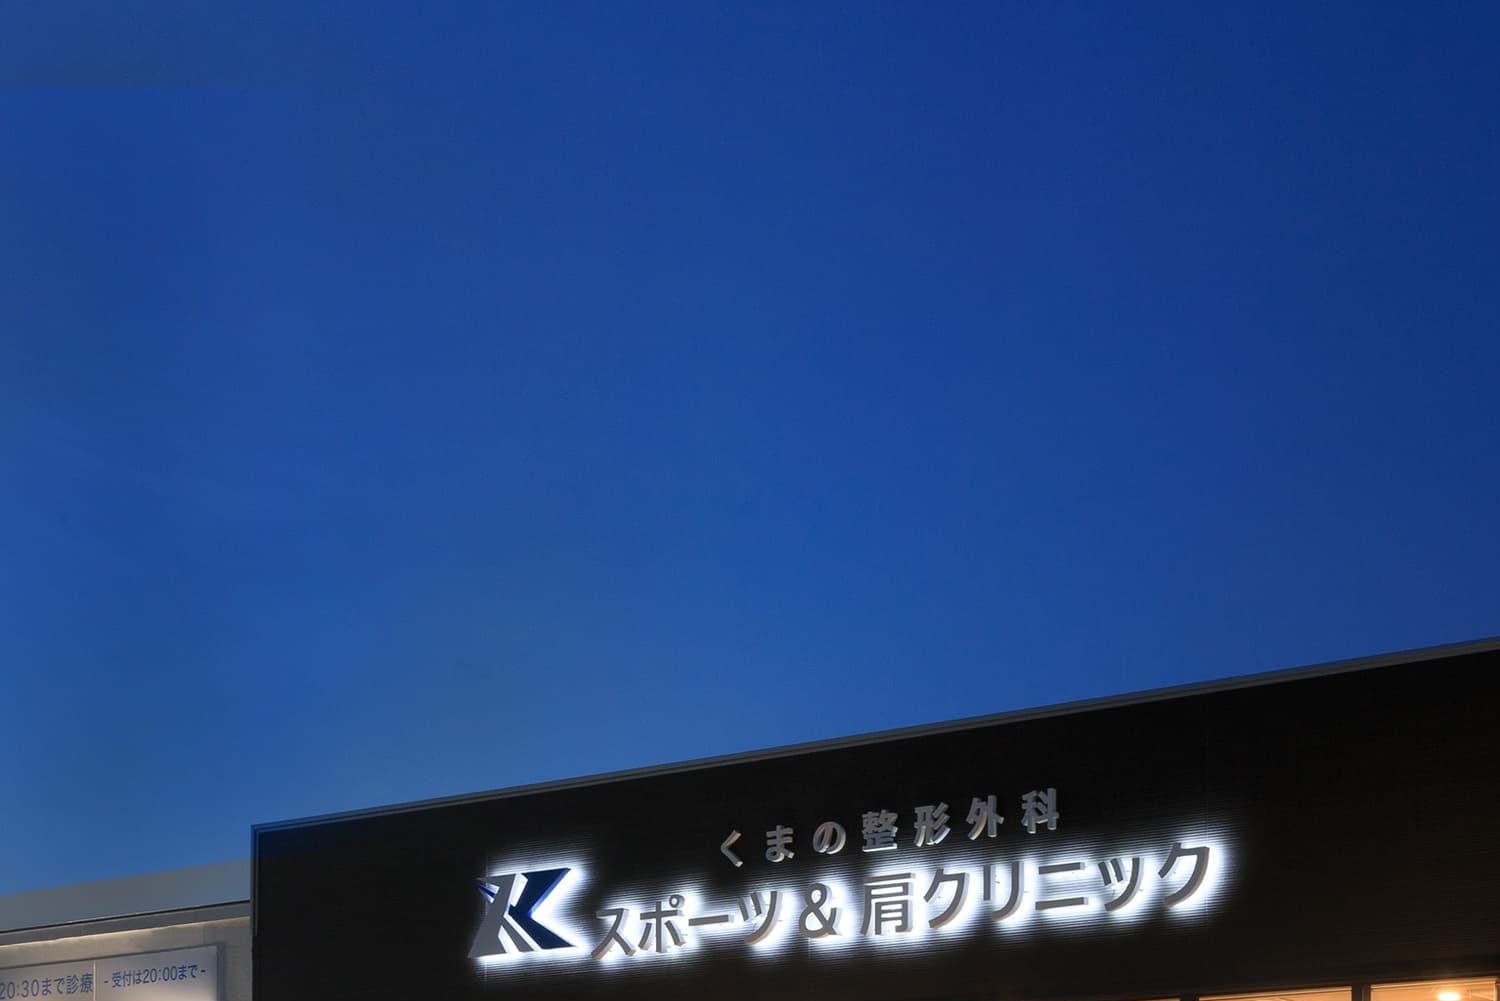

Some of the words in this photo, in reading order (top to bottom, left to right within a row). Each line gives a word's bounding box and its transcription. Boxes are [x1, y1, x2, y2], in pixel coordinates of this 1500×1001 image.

[720, 788, 1060, 867] くまの整形外科
[592, 842, 1210, 960] スポーツ&肩クリニック
